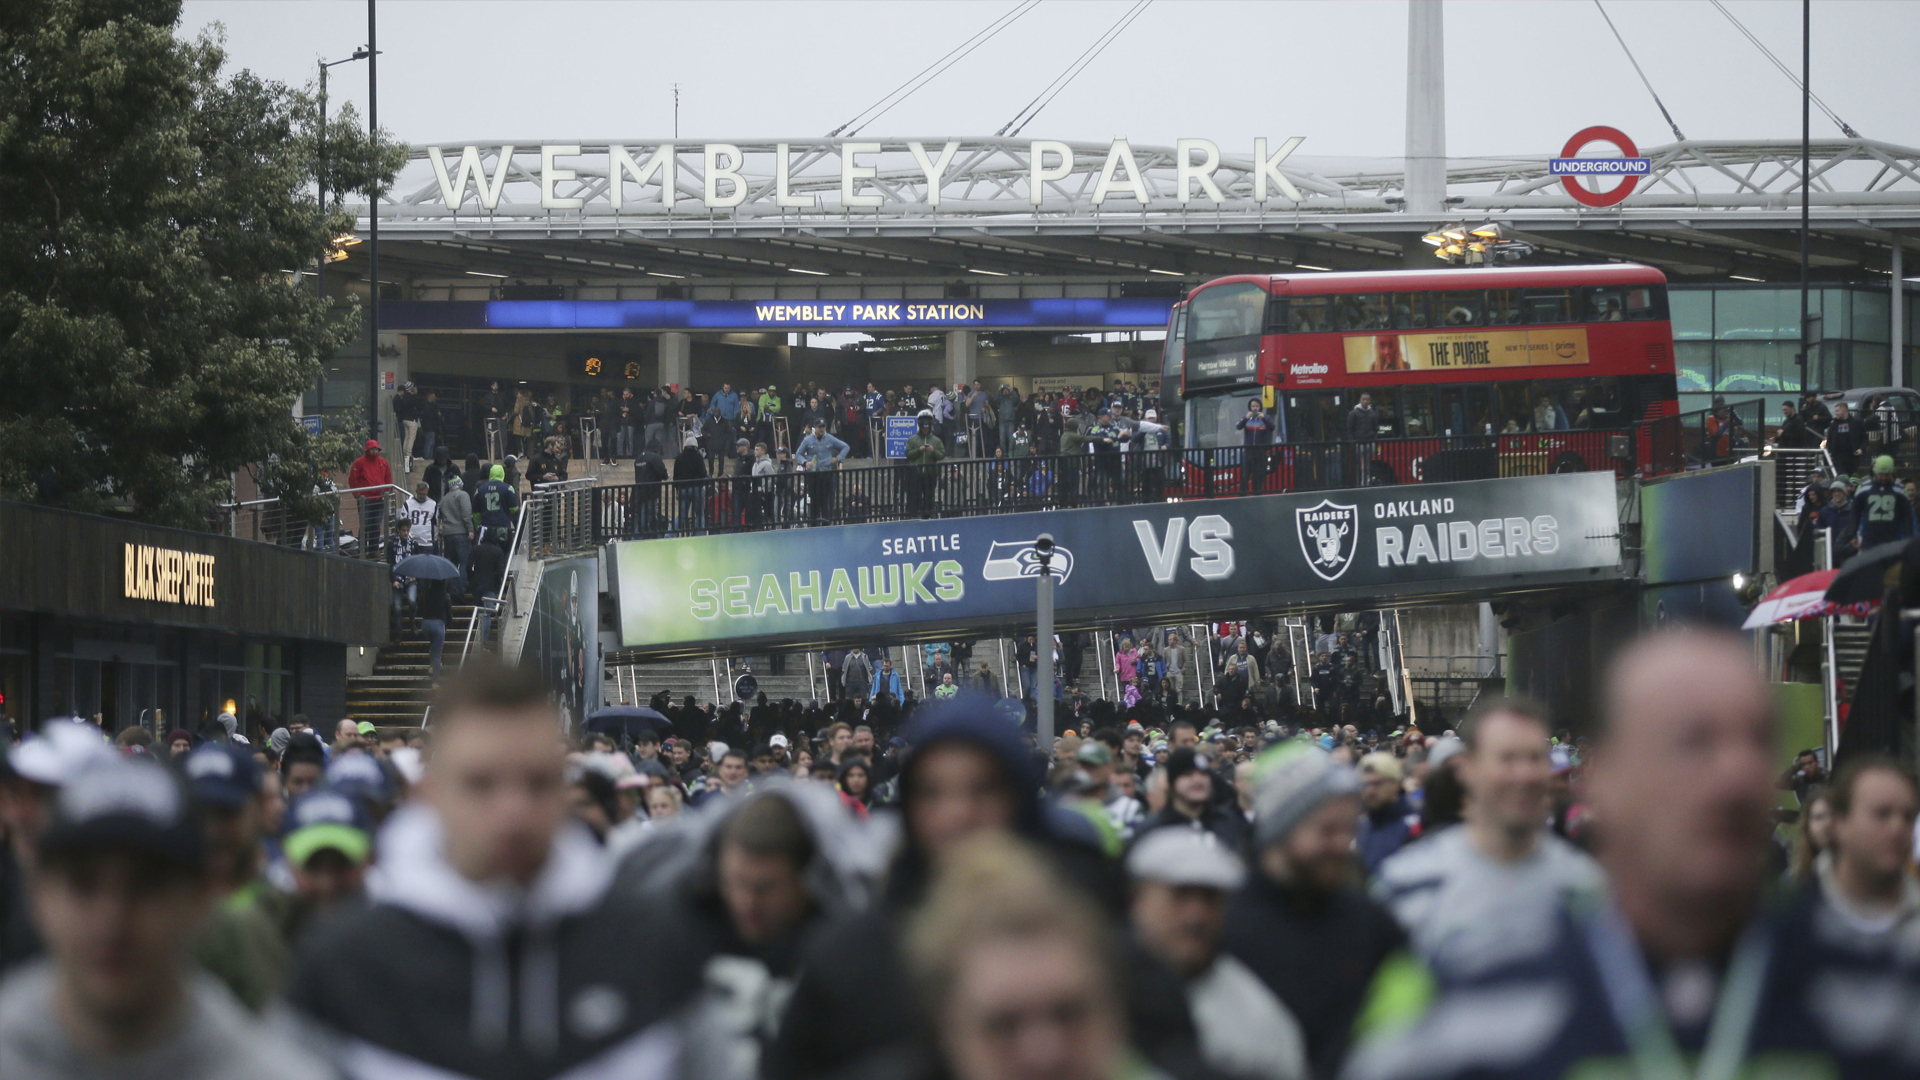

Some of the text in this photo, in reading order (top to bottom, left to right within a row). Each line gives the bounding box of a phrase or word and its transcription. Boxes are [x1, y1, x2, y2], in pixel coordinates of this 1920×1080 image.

[427, 136, 1307, 211] WEMBLEY PARK
[1552, 161, 1647, 173] UNDERGROUND
[755, 303, 985, 322] WEMBLEY PARK STATION
[1428, 340, 1491, 366] THE PURGE
[1529, 343, 1549, 351] SERIES
[1555, 341, 1576, 351] prime
[1198, 358, 1237, 371] Harrow Weald
[1245, 354, 1257, 371] 18
[1290, 363, 1329, 375] Metroline
[484, 492, 500, 511] 12
[1374, 498, 1455, 519] OAKLAND
[1867, 494, 1896, 521] 29
[411, 510, 430, 526] 87
[1303, 510, 1351, 523] RAIDERS
[882, 534, 961, 556] SEATTLE
[1132, 514, 1236, 585] VS
[1376, 514, 1561, 568] RAIDERS
[125, 542, 215, 607] BLACK SHEEP COFFEE
[689, 559, 966, 620] SEAHAWKS
[1147, 662, 1157, 675] 3
